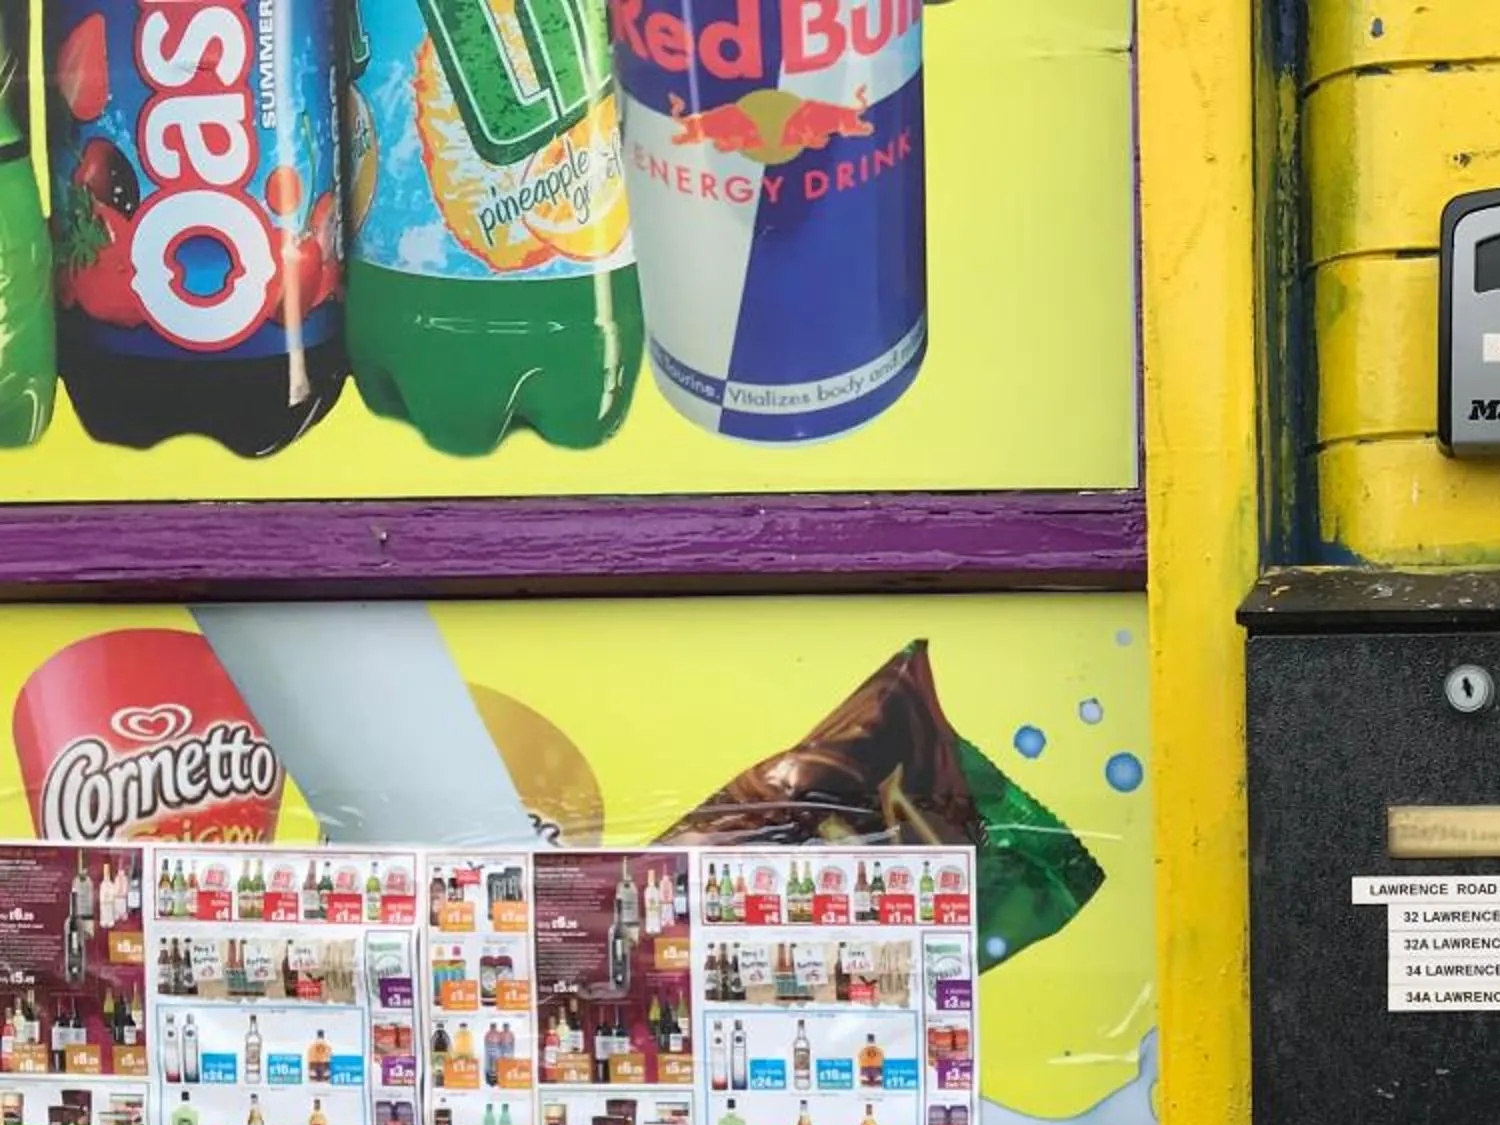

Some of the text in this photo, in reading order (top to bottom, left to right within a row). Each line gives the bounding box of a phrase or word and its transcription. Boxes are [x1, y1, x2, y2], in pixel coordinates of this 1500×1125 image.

[781, 0, 921, 74] Bu
[131, 0, 276, 342] Oas
[634, 143, 783, 203] ENERGY
[804, 128, 911, 199] DRINK
[479, 135, 589, 247] pineapple
[728, 386, 811, 406] Vitalizes
[817, 374, 864, 401] body
[41, 722, 278, 841] Cornetto
[1369, 883, 1448, 896] LAWRENCE
[1457, 883, 1497, 896] ROAD
[1403, 911, 1420, 923] 32
[1423, 911, 1500, 923] LAWRENCE
[1404, 938, 1429, 950] 32A
[1406, 965, 1422, 977] 34
[1406, 991, 1431, 1003] 34A
